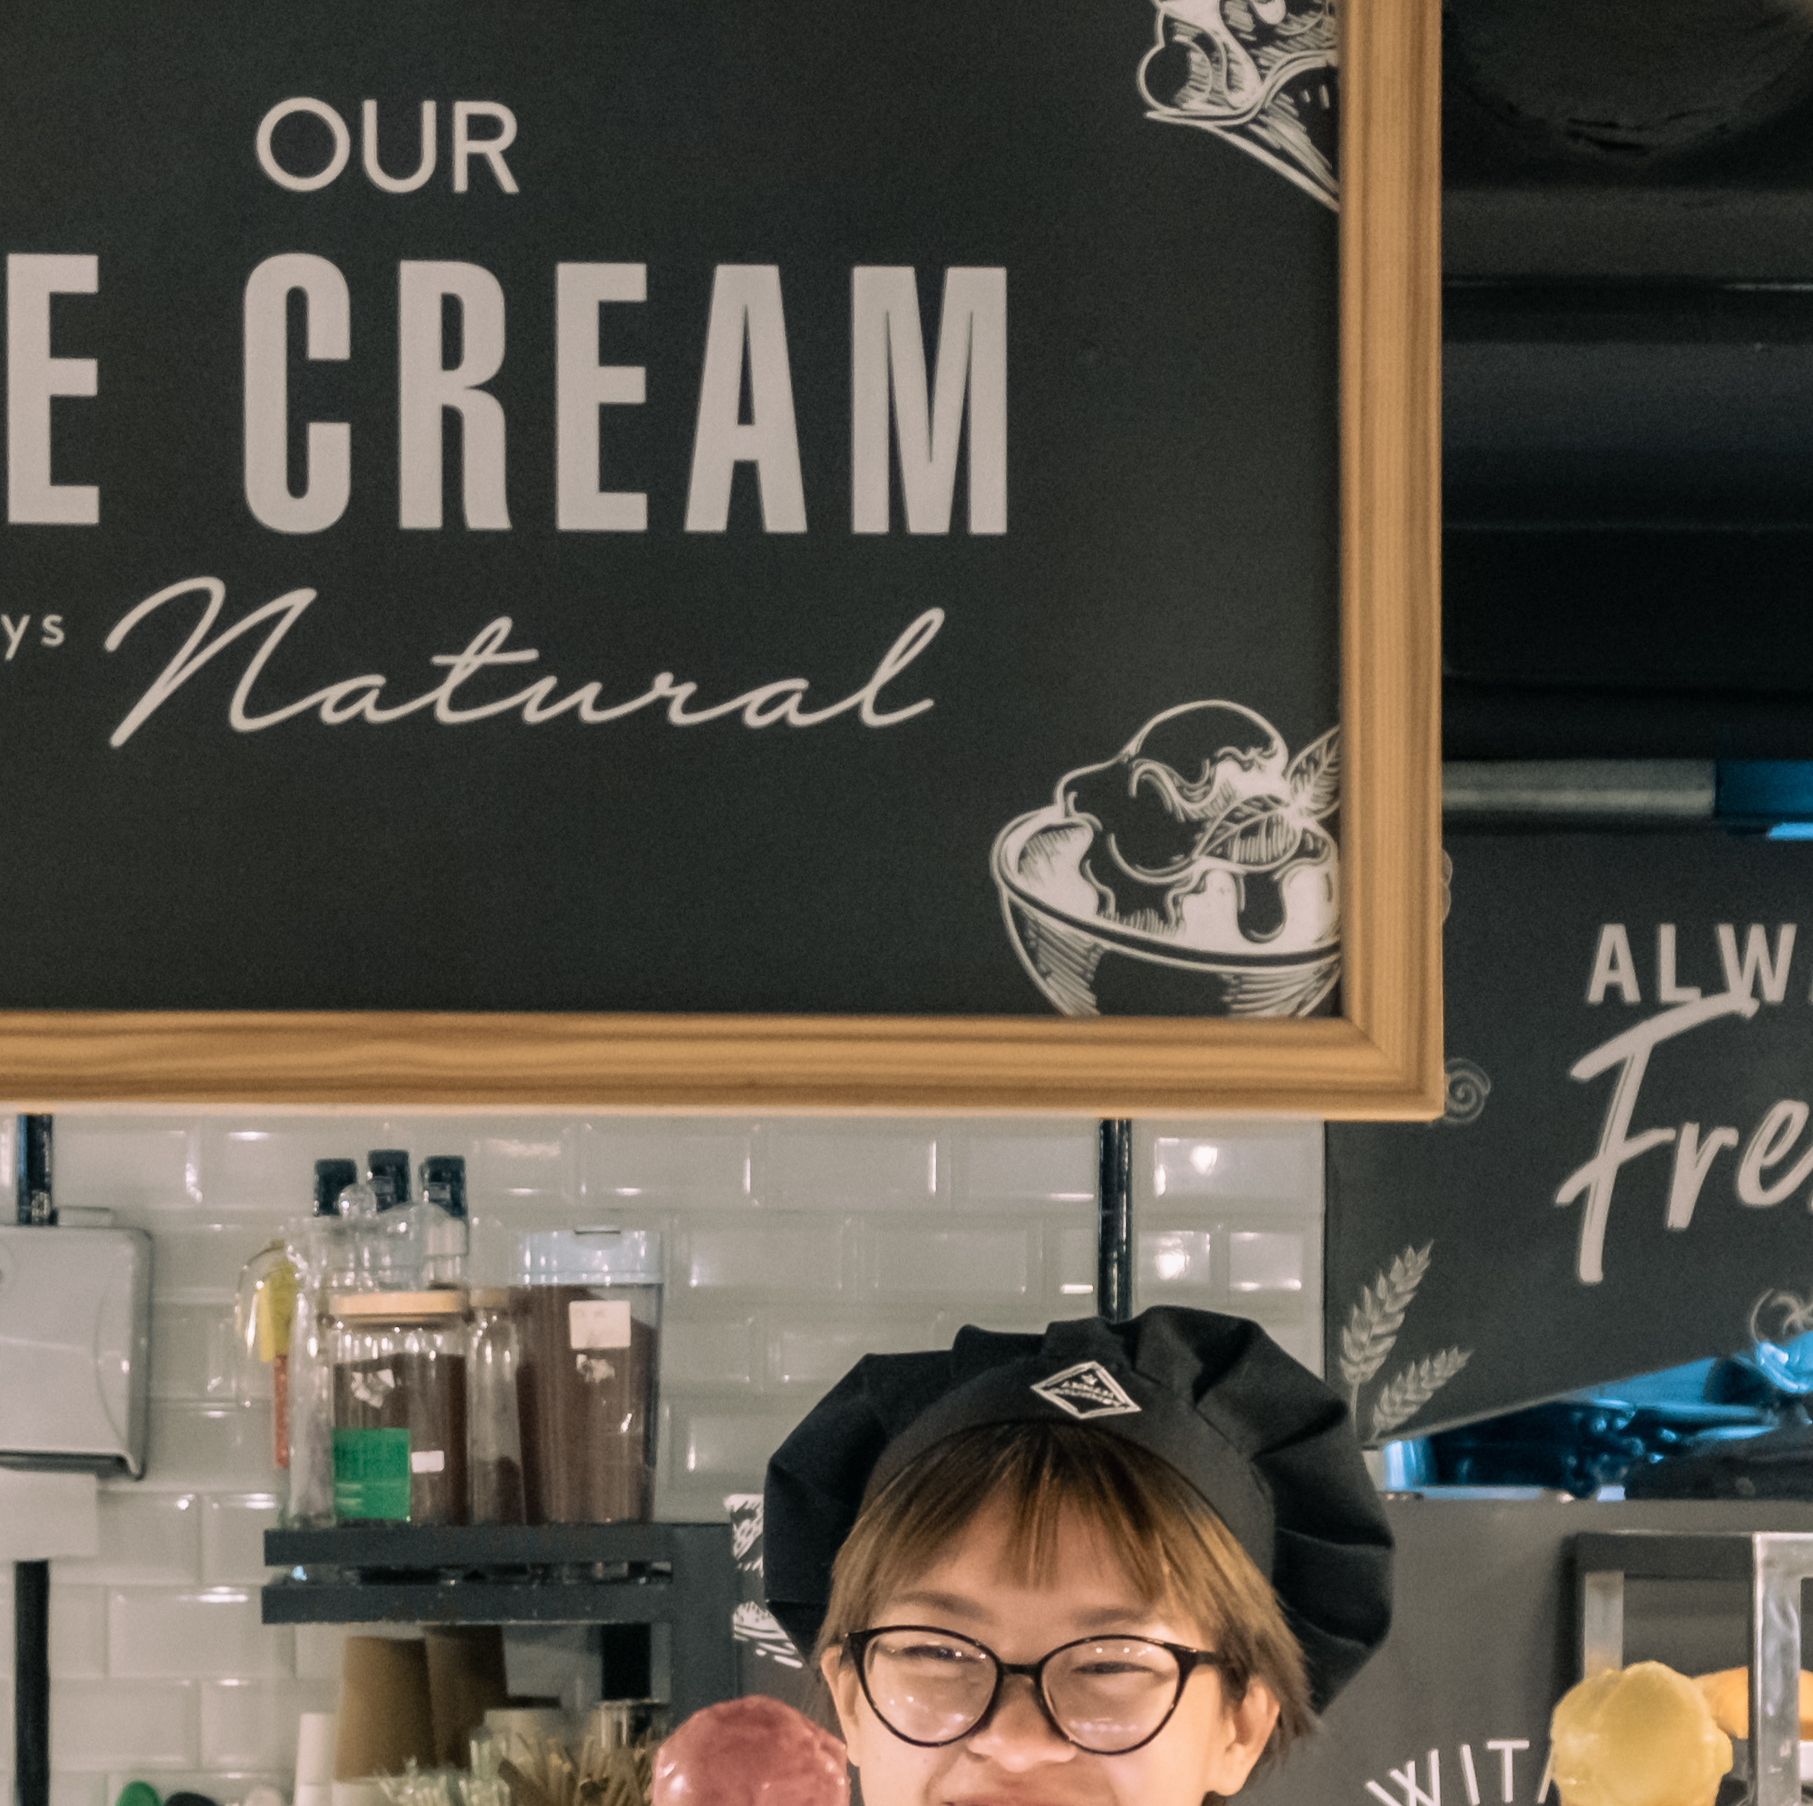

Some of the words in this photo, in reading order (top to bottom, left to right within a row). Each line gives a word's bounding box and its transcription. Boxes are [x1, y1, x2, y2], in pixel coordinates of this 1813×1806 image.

[255, 96, 520, 194] OUR
[242, 252, 1008, 536] CREAM
[104, 576, 947, 749] Natural
